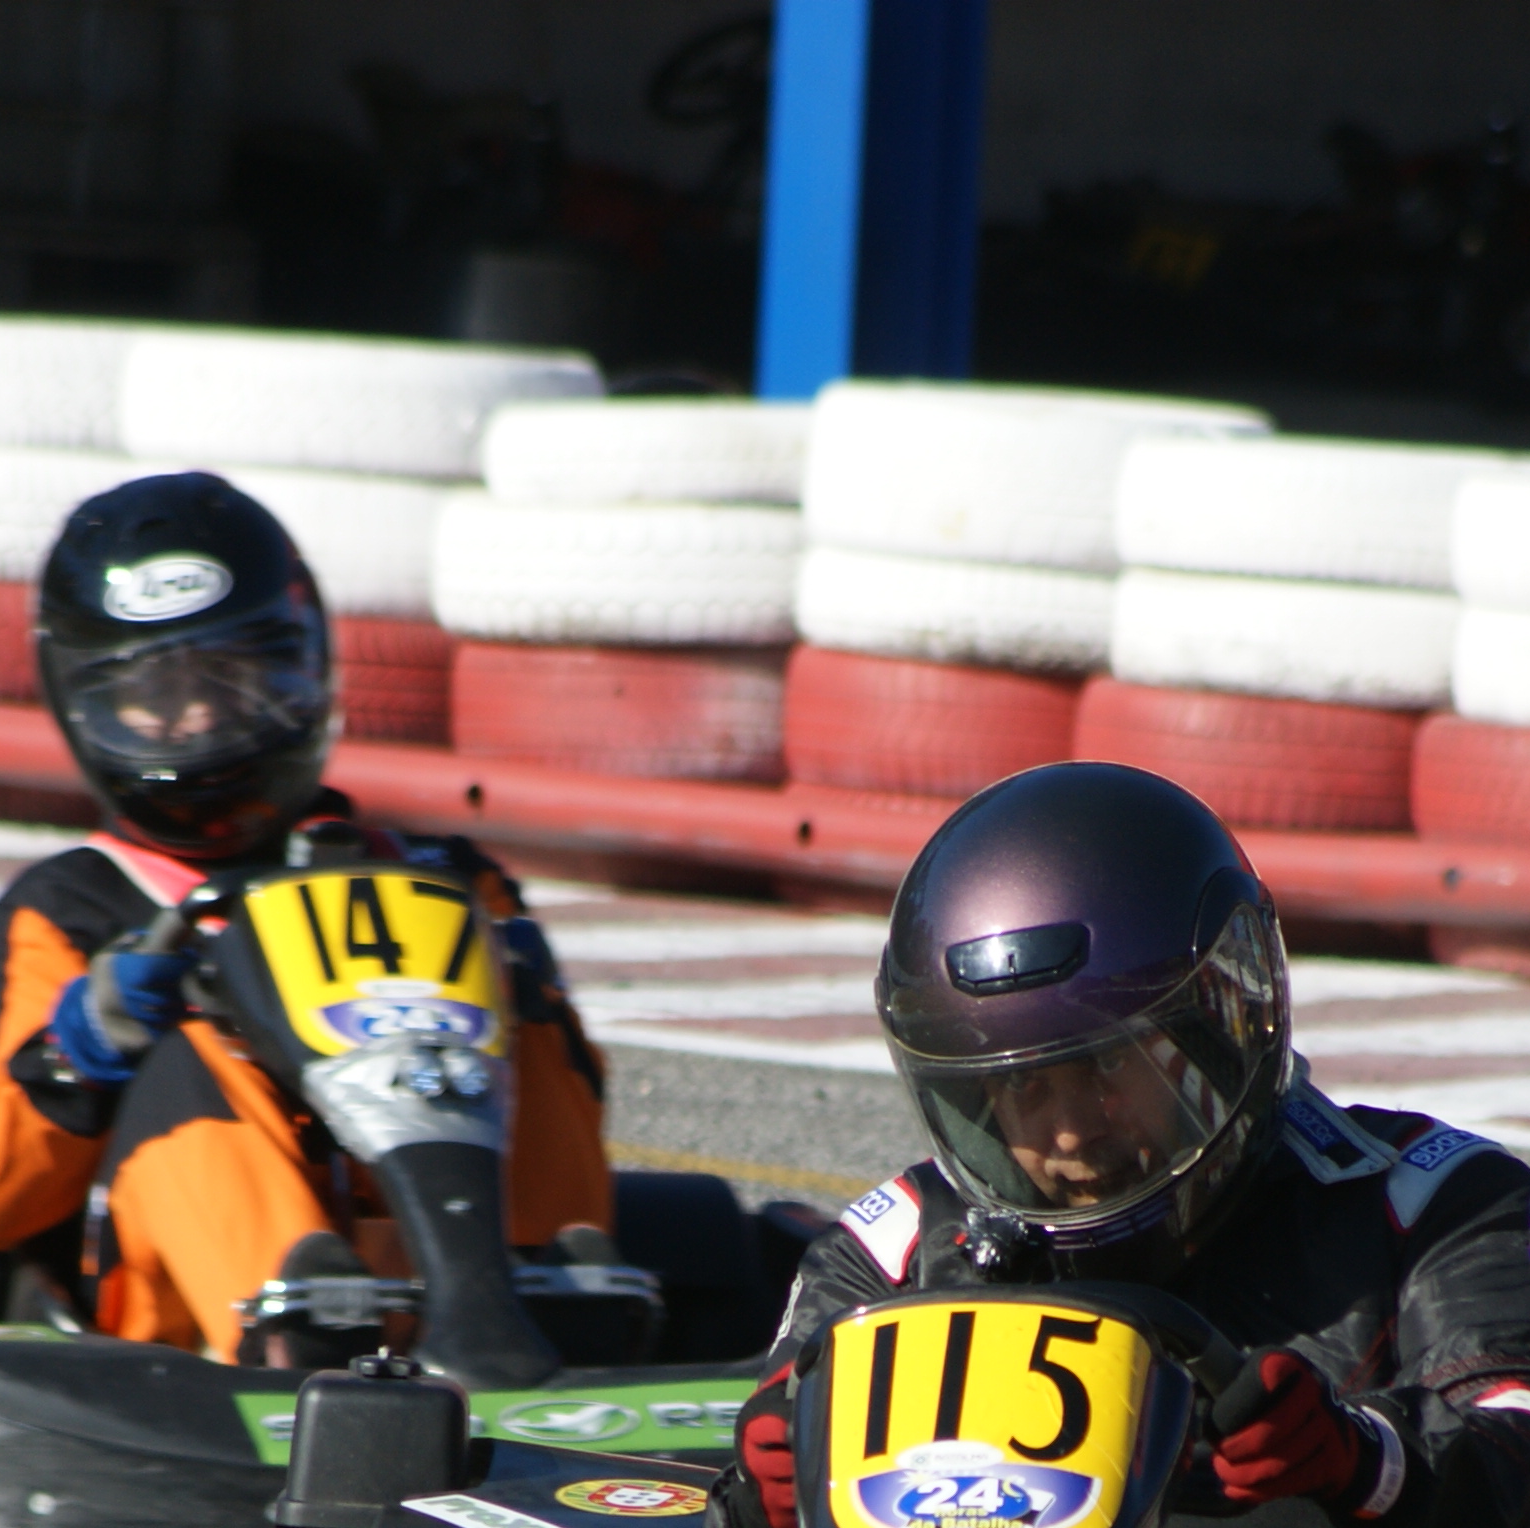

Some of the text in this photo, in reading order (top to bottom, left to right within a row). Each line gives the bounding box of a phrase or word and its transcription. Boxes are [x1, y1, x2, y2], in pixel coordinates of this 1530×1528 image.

[297, 877, 473, 985] 147
[863, 1311, 1103, 1462] 115
[914, 1477, 1005, 1515] 24
